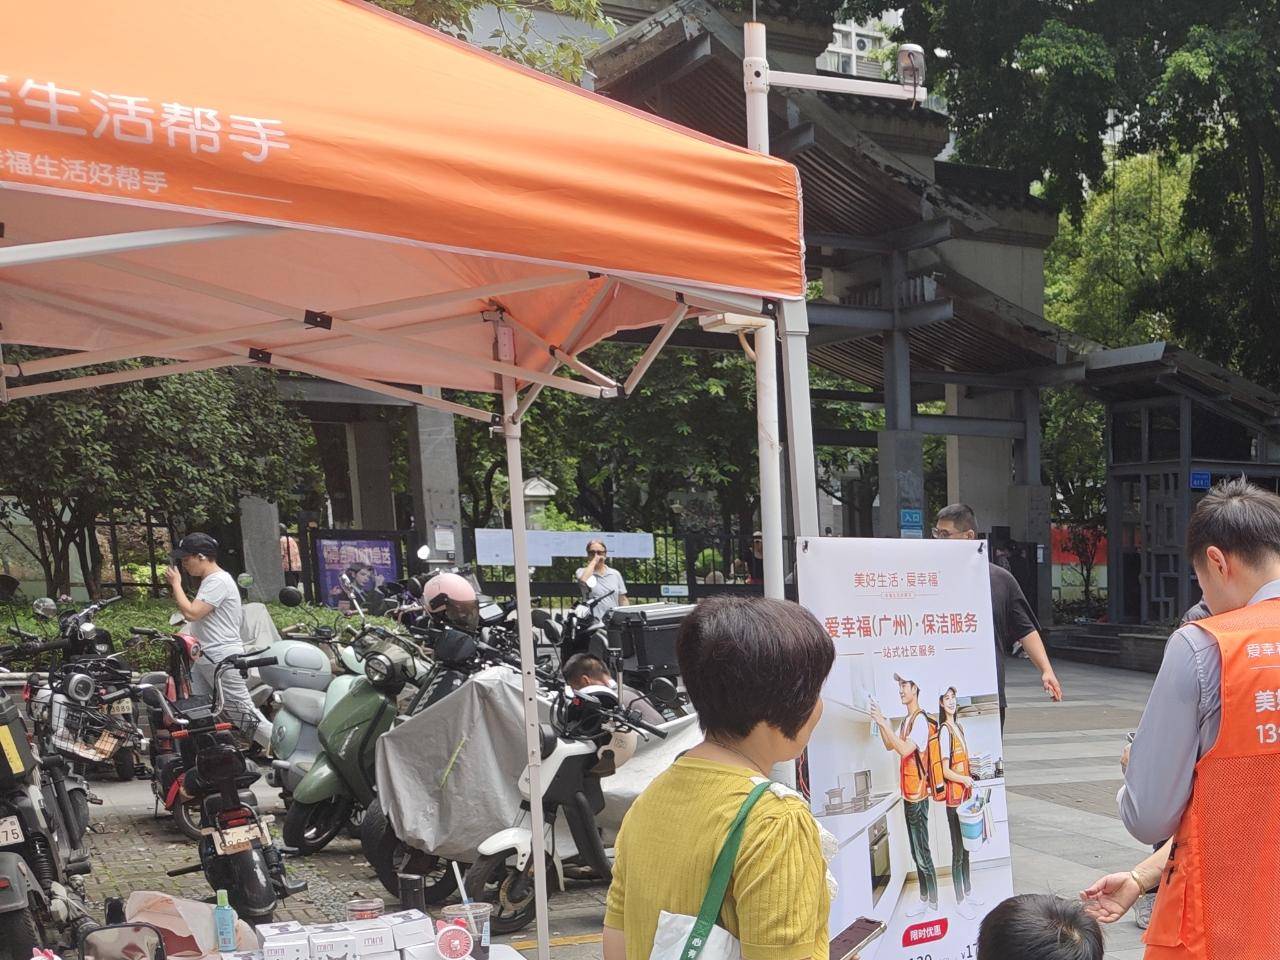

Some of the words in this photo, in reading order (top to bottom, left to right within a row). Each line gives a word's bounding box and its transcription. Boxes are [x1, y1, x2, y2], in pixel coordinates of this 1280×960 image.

[0, 74, 290, 163] 生活帮手
[0, 149, 168, 194] 福生活好帮手
[873, 645, 936, 659] 一站式社区服务
[910, 924, 942, 942] 限时优惠
